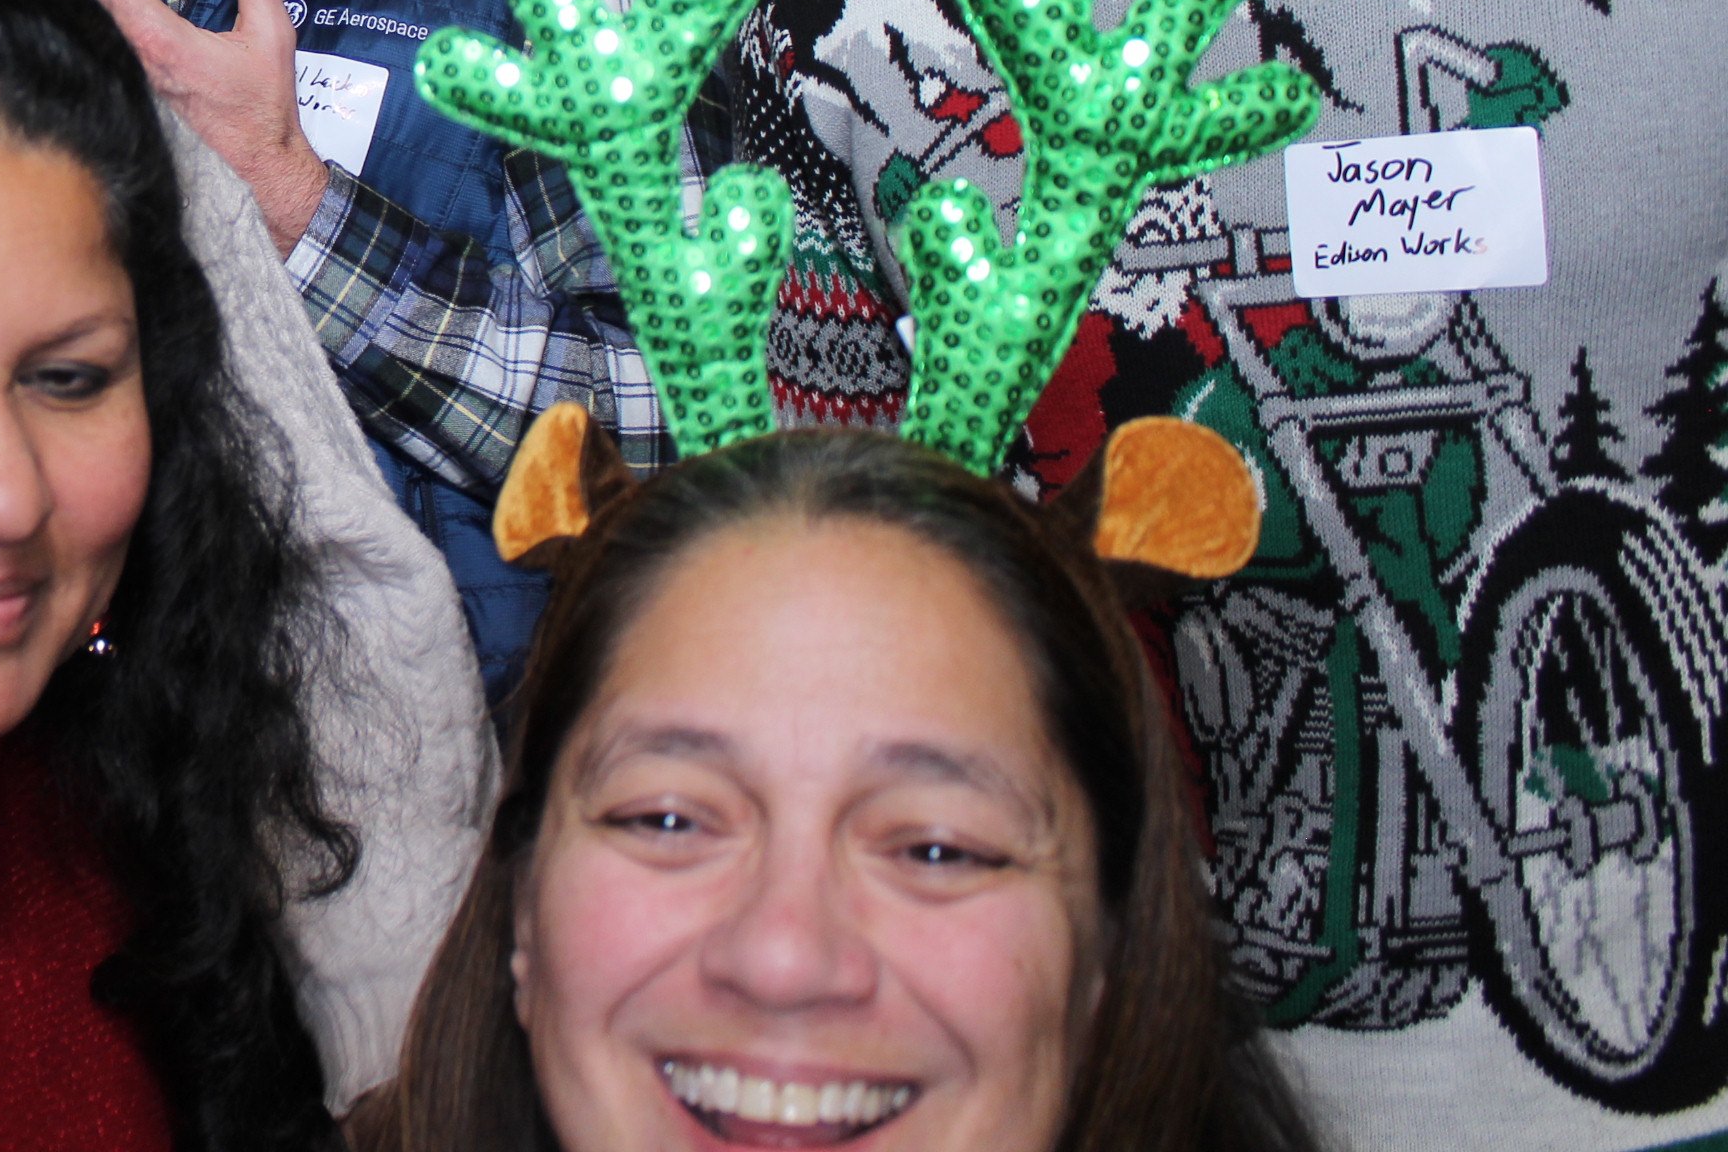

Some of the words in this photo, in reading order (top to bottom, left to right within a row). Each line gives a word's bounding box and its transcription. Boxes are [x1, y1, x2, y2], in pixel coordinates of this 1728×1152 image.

[314, 8, 338, 26] GE
[338, 8, 429, 41] Aerospace
[1322, 141, 1433, 183] Jason
[1348, 185, 1476, 230] Mayer
[1314, 241, 1388, 269] Edison
[1400, 228, 1489, 255] Works
